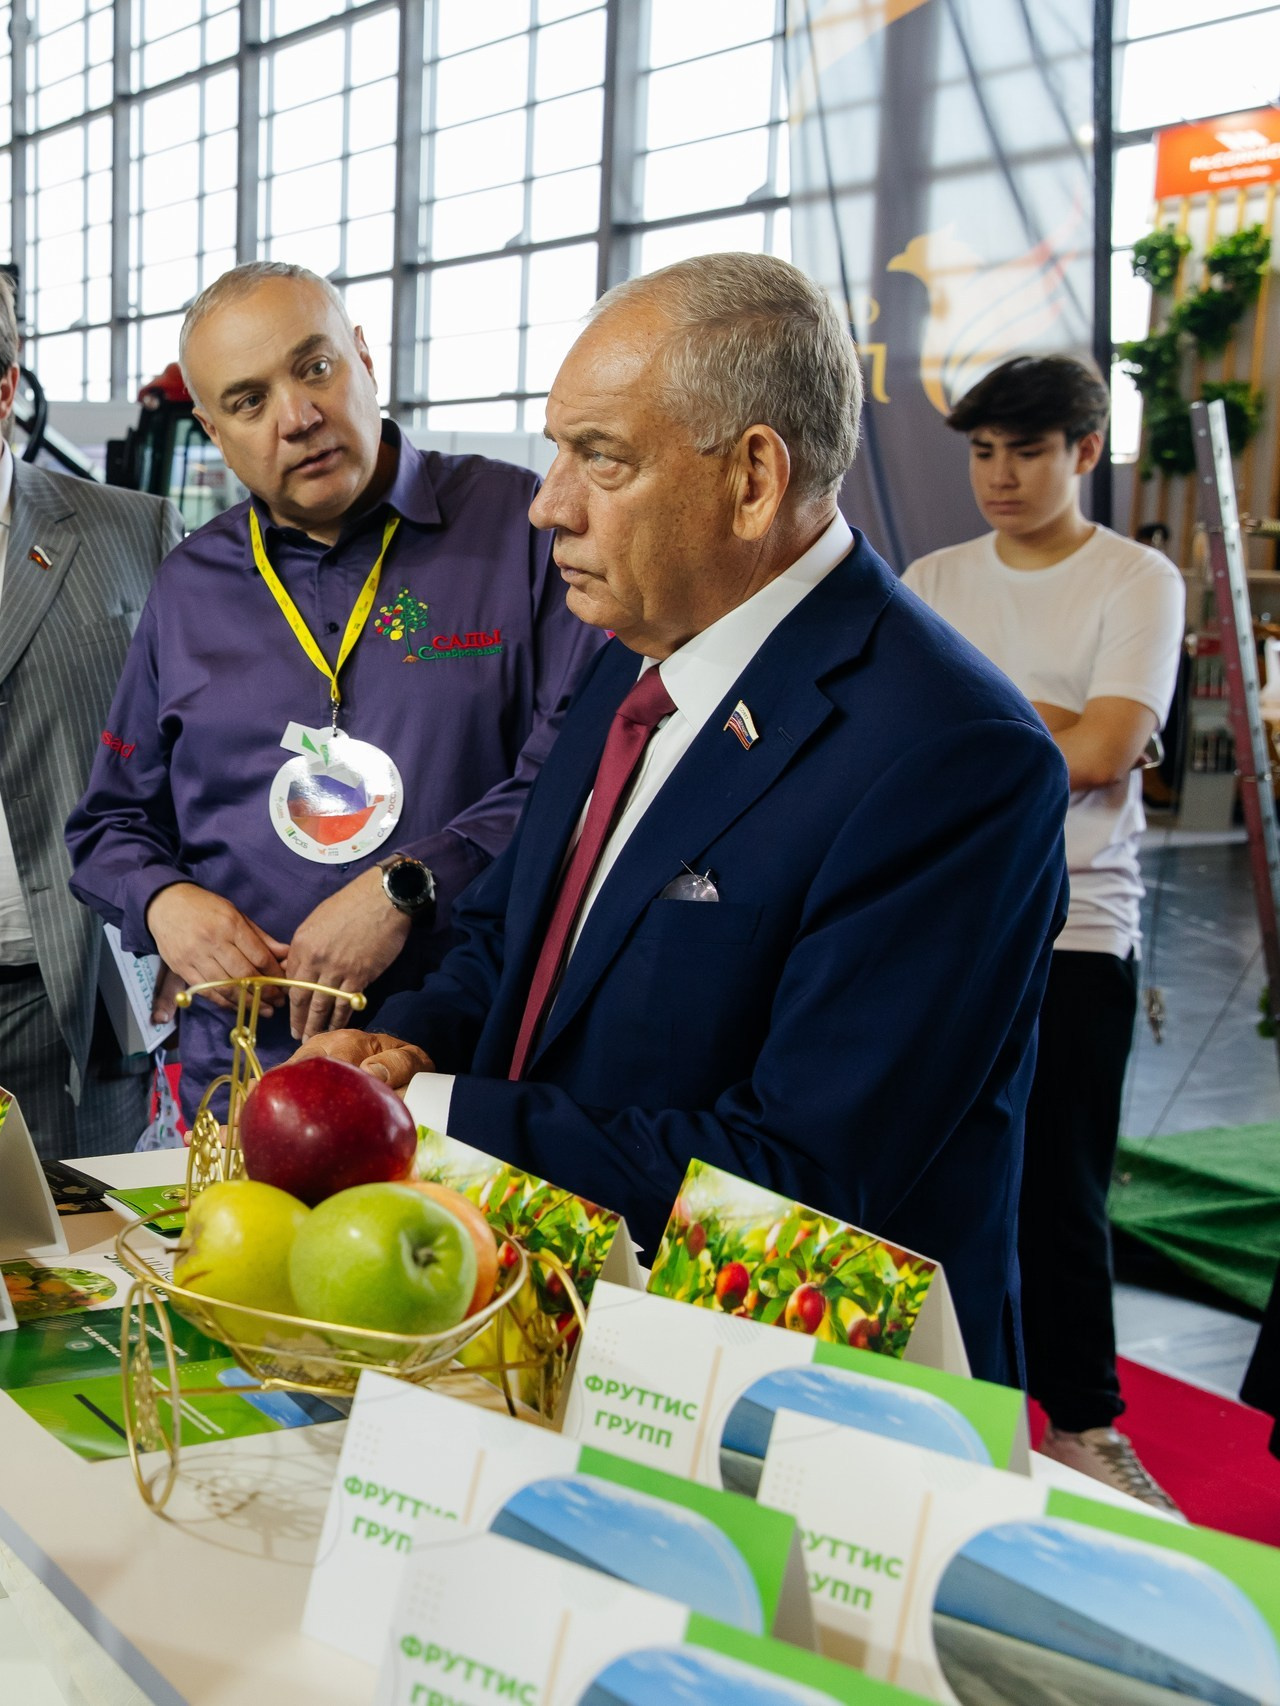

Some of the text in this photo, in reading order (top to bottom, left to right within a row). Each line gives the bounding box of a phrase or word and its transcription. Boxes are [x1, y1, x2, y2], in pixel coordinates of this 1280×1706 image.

[432, 628, 501, 650] САДЫ
[584, 1374, 698, 1421] ФРУТТИС
[594, 1410, 672, 1448] ГРУПП
[344, 1476, 457, 1519] ФРУТТ
[352, 1516, 413, 1553] ГРУП
[800, 1530, 903, 1579] УТТИС
[809, 1572, 872, 1611] УПП
[400, 1634, 537, 1706] ФРУТТИС
